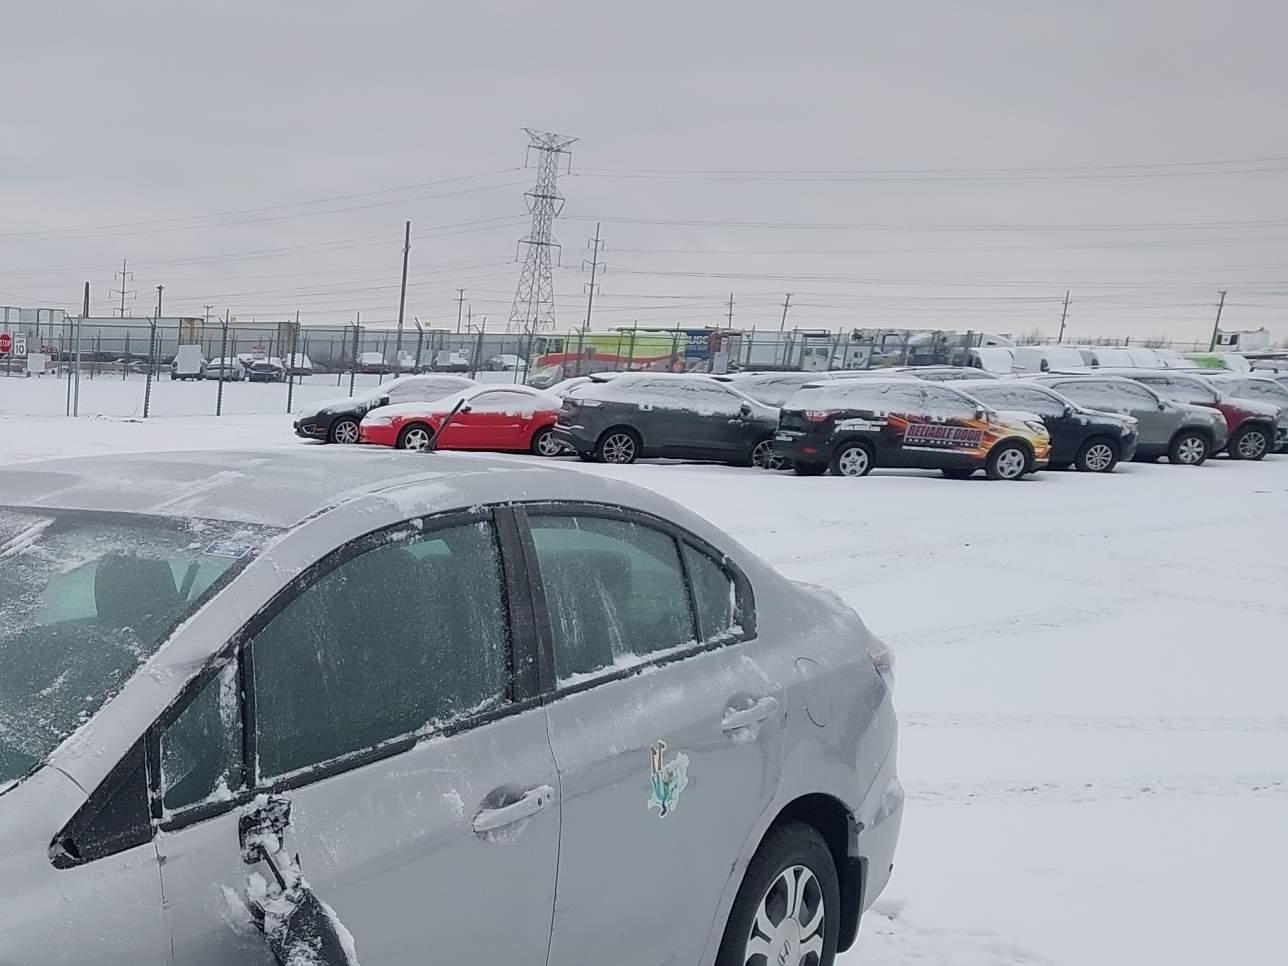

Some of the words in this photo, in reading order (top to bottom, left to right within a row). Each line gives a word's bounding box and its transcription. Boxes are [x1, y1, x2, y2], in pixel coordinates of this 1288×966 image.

[16, 344, 24, 354] 10
[907, 424, 953, 440] RELIABLE
[952, 428, 983, 442] DOOR
